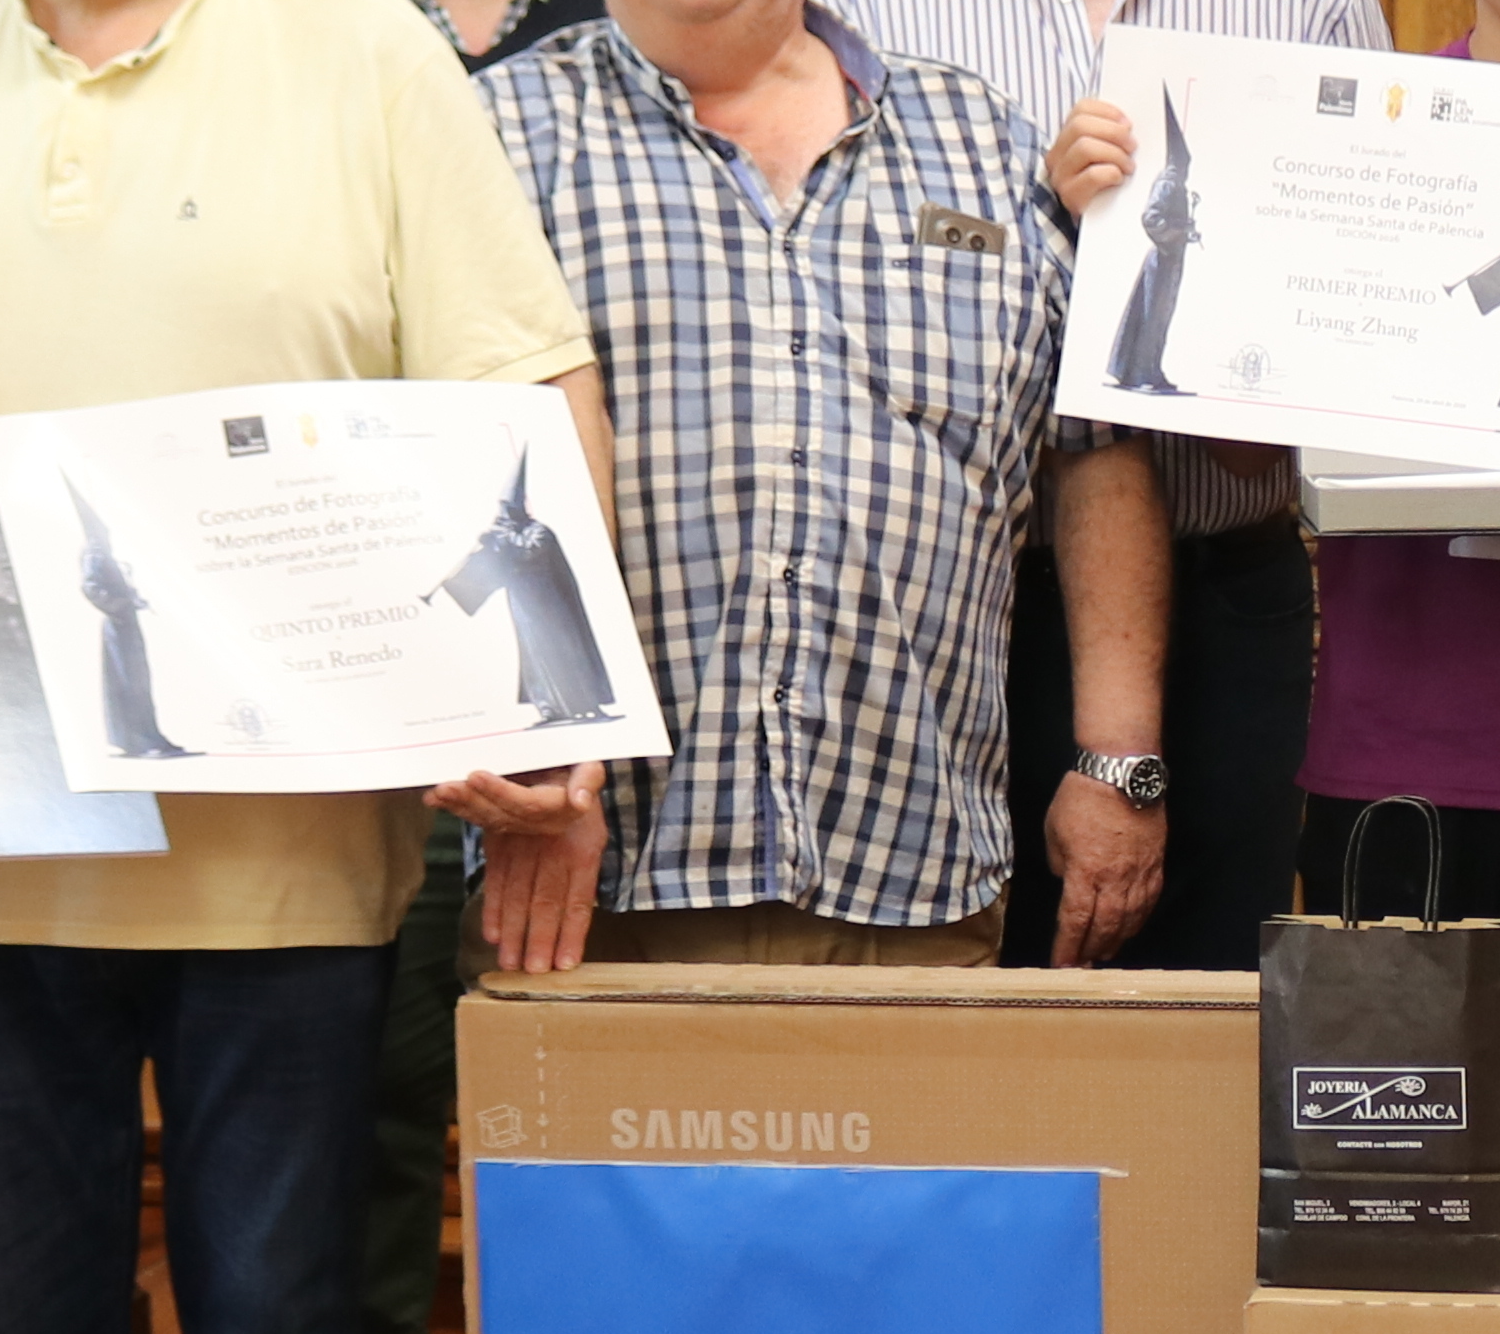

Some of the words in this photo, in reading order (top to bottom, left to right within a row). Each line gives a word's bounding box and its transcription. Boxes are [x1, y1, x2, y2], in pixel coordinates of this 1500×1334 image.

[1272, 156, 1356, 179] Concurso
[1359, 166, 1381, 183] de
[1386, 167, 1478, 193] Fotografía
[1380, 193, 1401, 211] de
[1255, 204, 1292, 219] sobre
[1295, 207, 1306, 220] la
[1310, 209, 1364, 227] Semana
[1367, 215, 1406, 231] Santa
[1409, 219, 1425, 233] de
[1429, 221, 1485, 239] Palencia
[1286, 274, 1358, 297] PRIMER
[1362, 283, 1437, 305] PREMIO
[1295, 308, 1357, 337] Liyang
[1360, 315, 1420, 344] Zhang
[198, 501, 290, 527] Concurso
[294, 495, 318, 513] de
[324, 519, 349, 537] de
[250, 617, 334, 643] QUINTO
[340, 605, 420, 631] PREMIO
[282, 655, 326, 673] Sara
[329, 643, 403, 668] Renedo
[1308, 1080, 1370, 1095] JOYERIA
[610, 1107, 871, 1153] SAMSUNG
